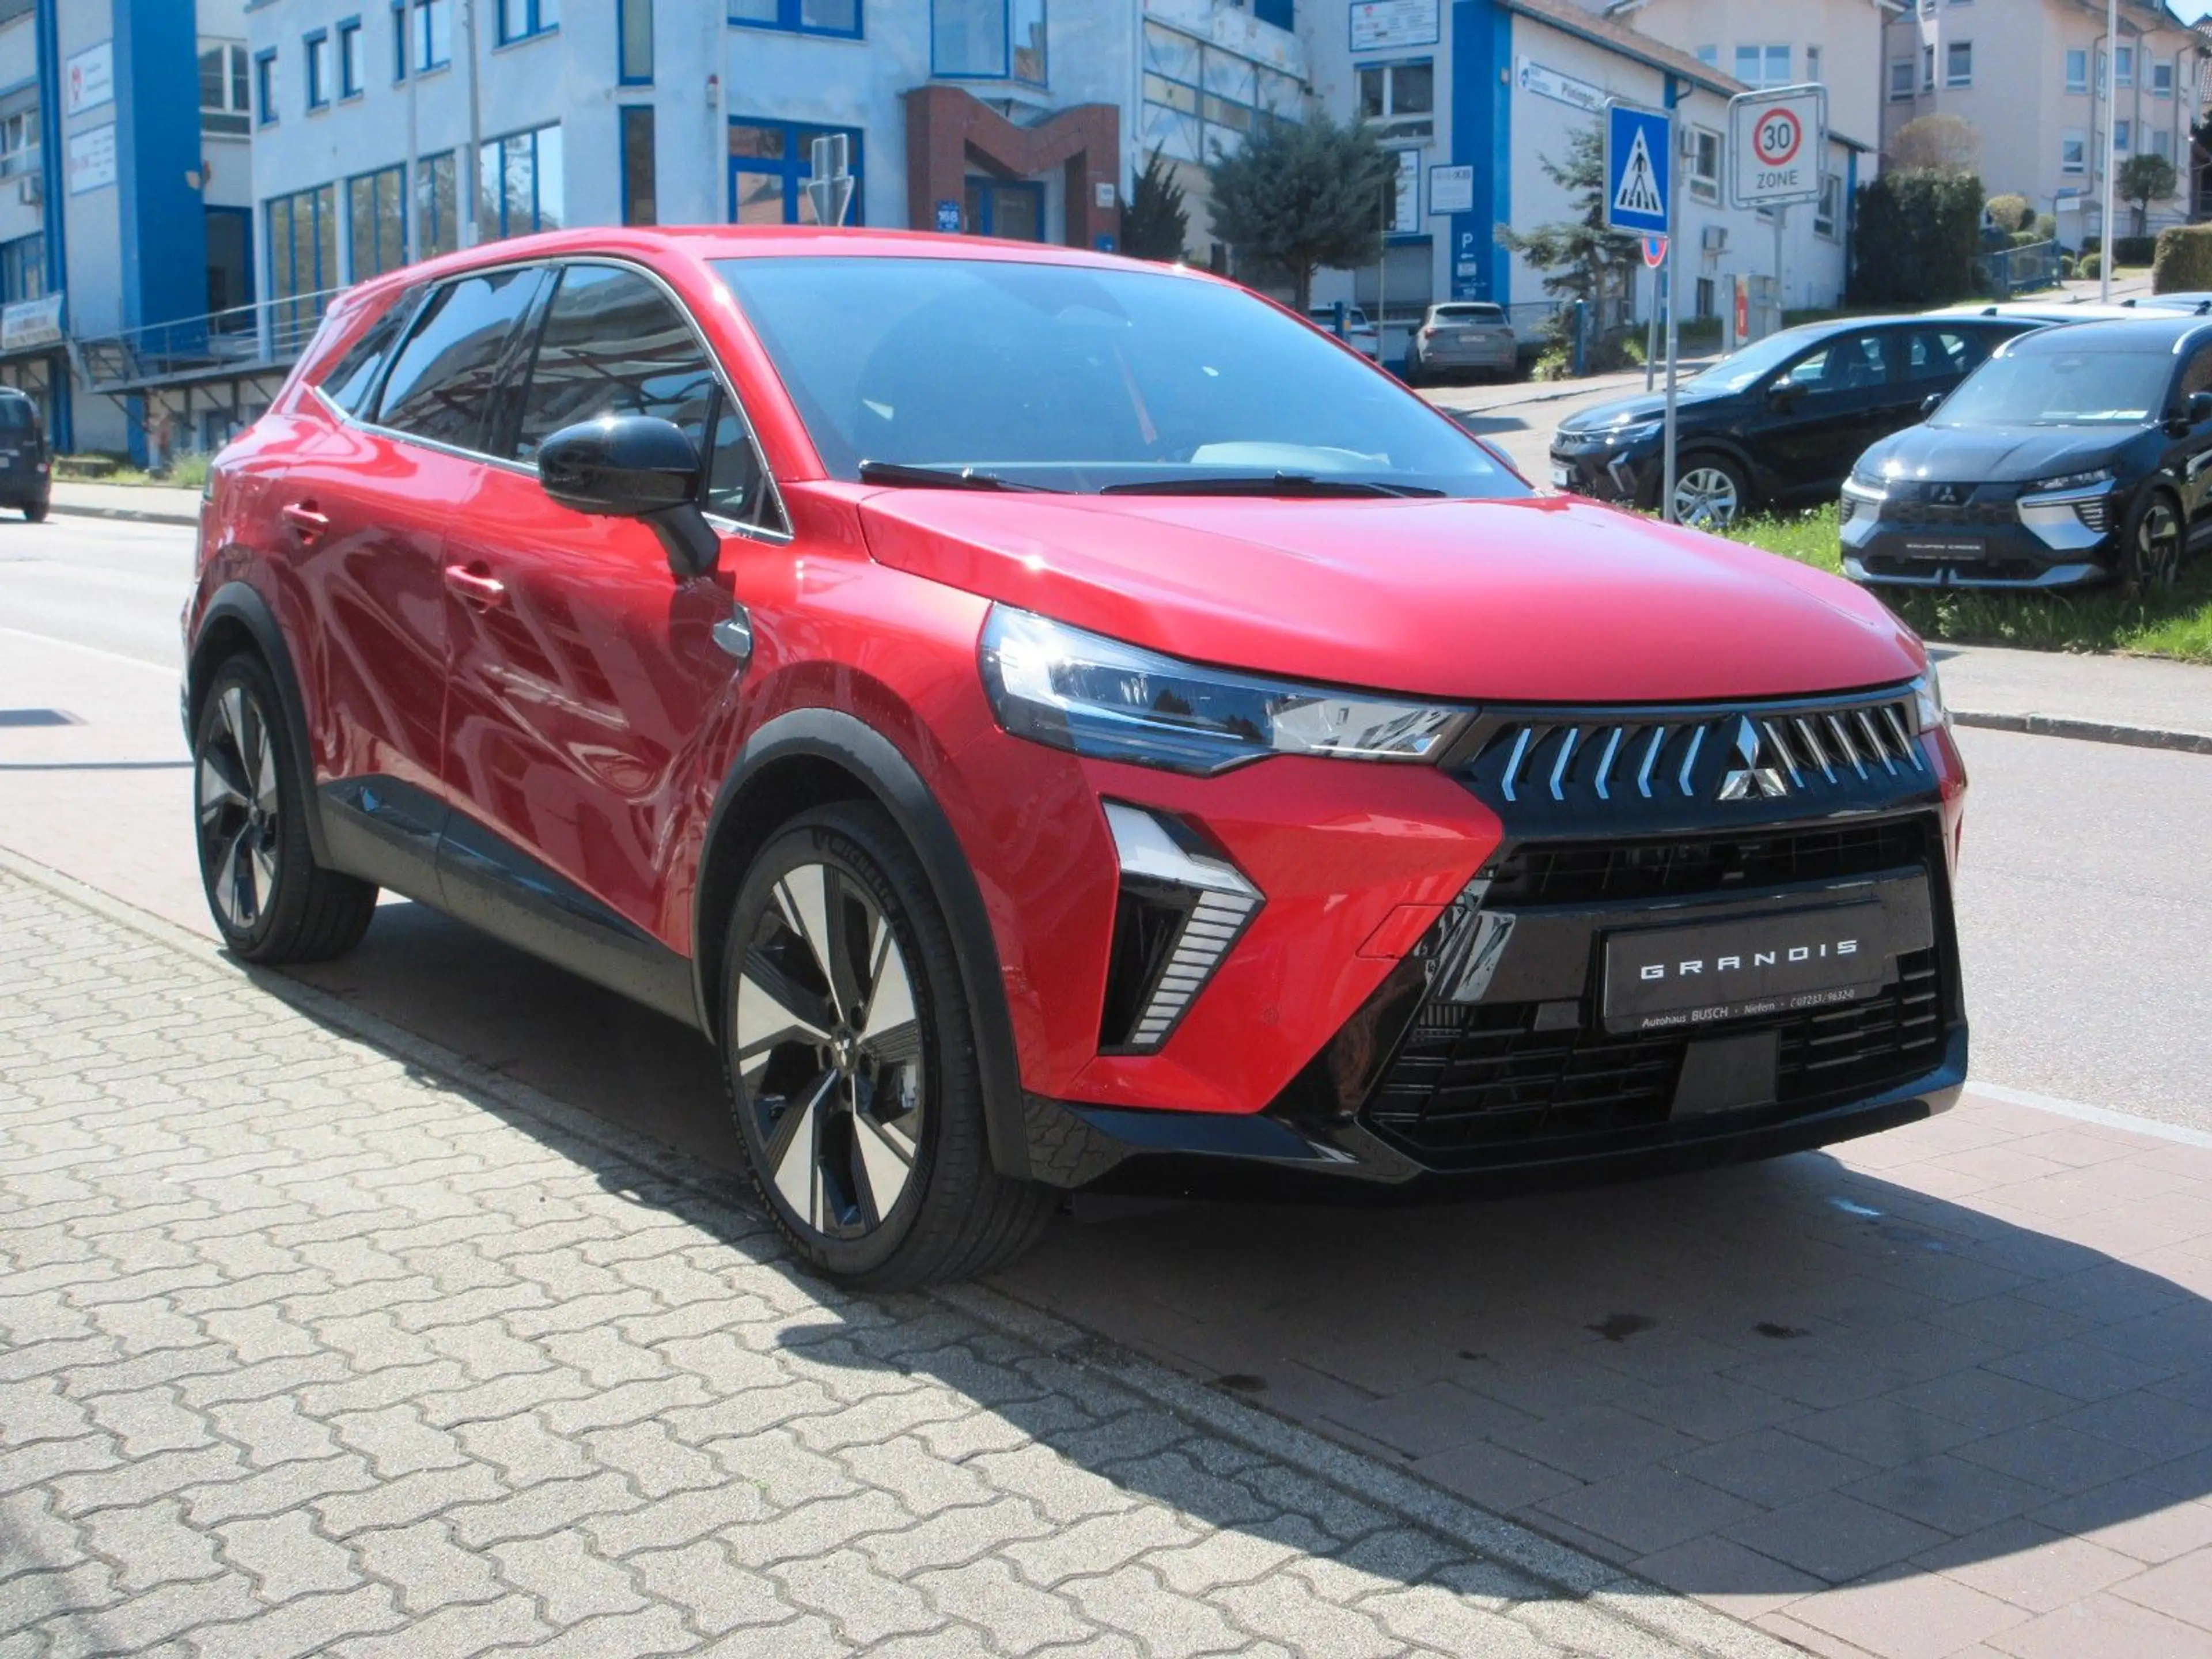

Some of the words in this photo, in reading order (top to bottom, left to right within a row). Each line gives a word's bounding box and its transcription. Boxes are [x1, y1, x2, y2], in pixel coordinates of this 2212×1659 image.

[1763, 123, 1790, 150] 30
[1758, 170, 1798, 189] ZONE
[1641, 940, 1857, 979] GRANDIS
[1642, 1015, 1687, 1028] Autohaus
[1691, 1006, 1728, 1022] BUSCH
